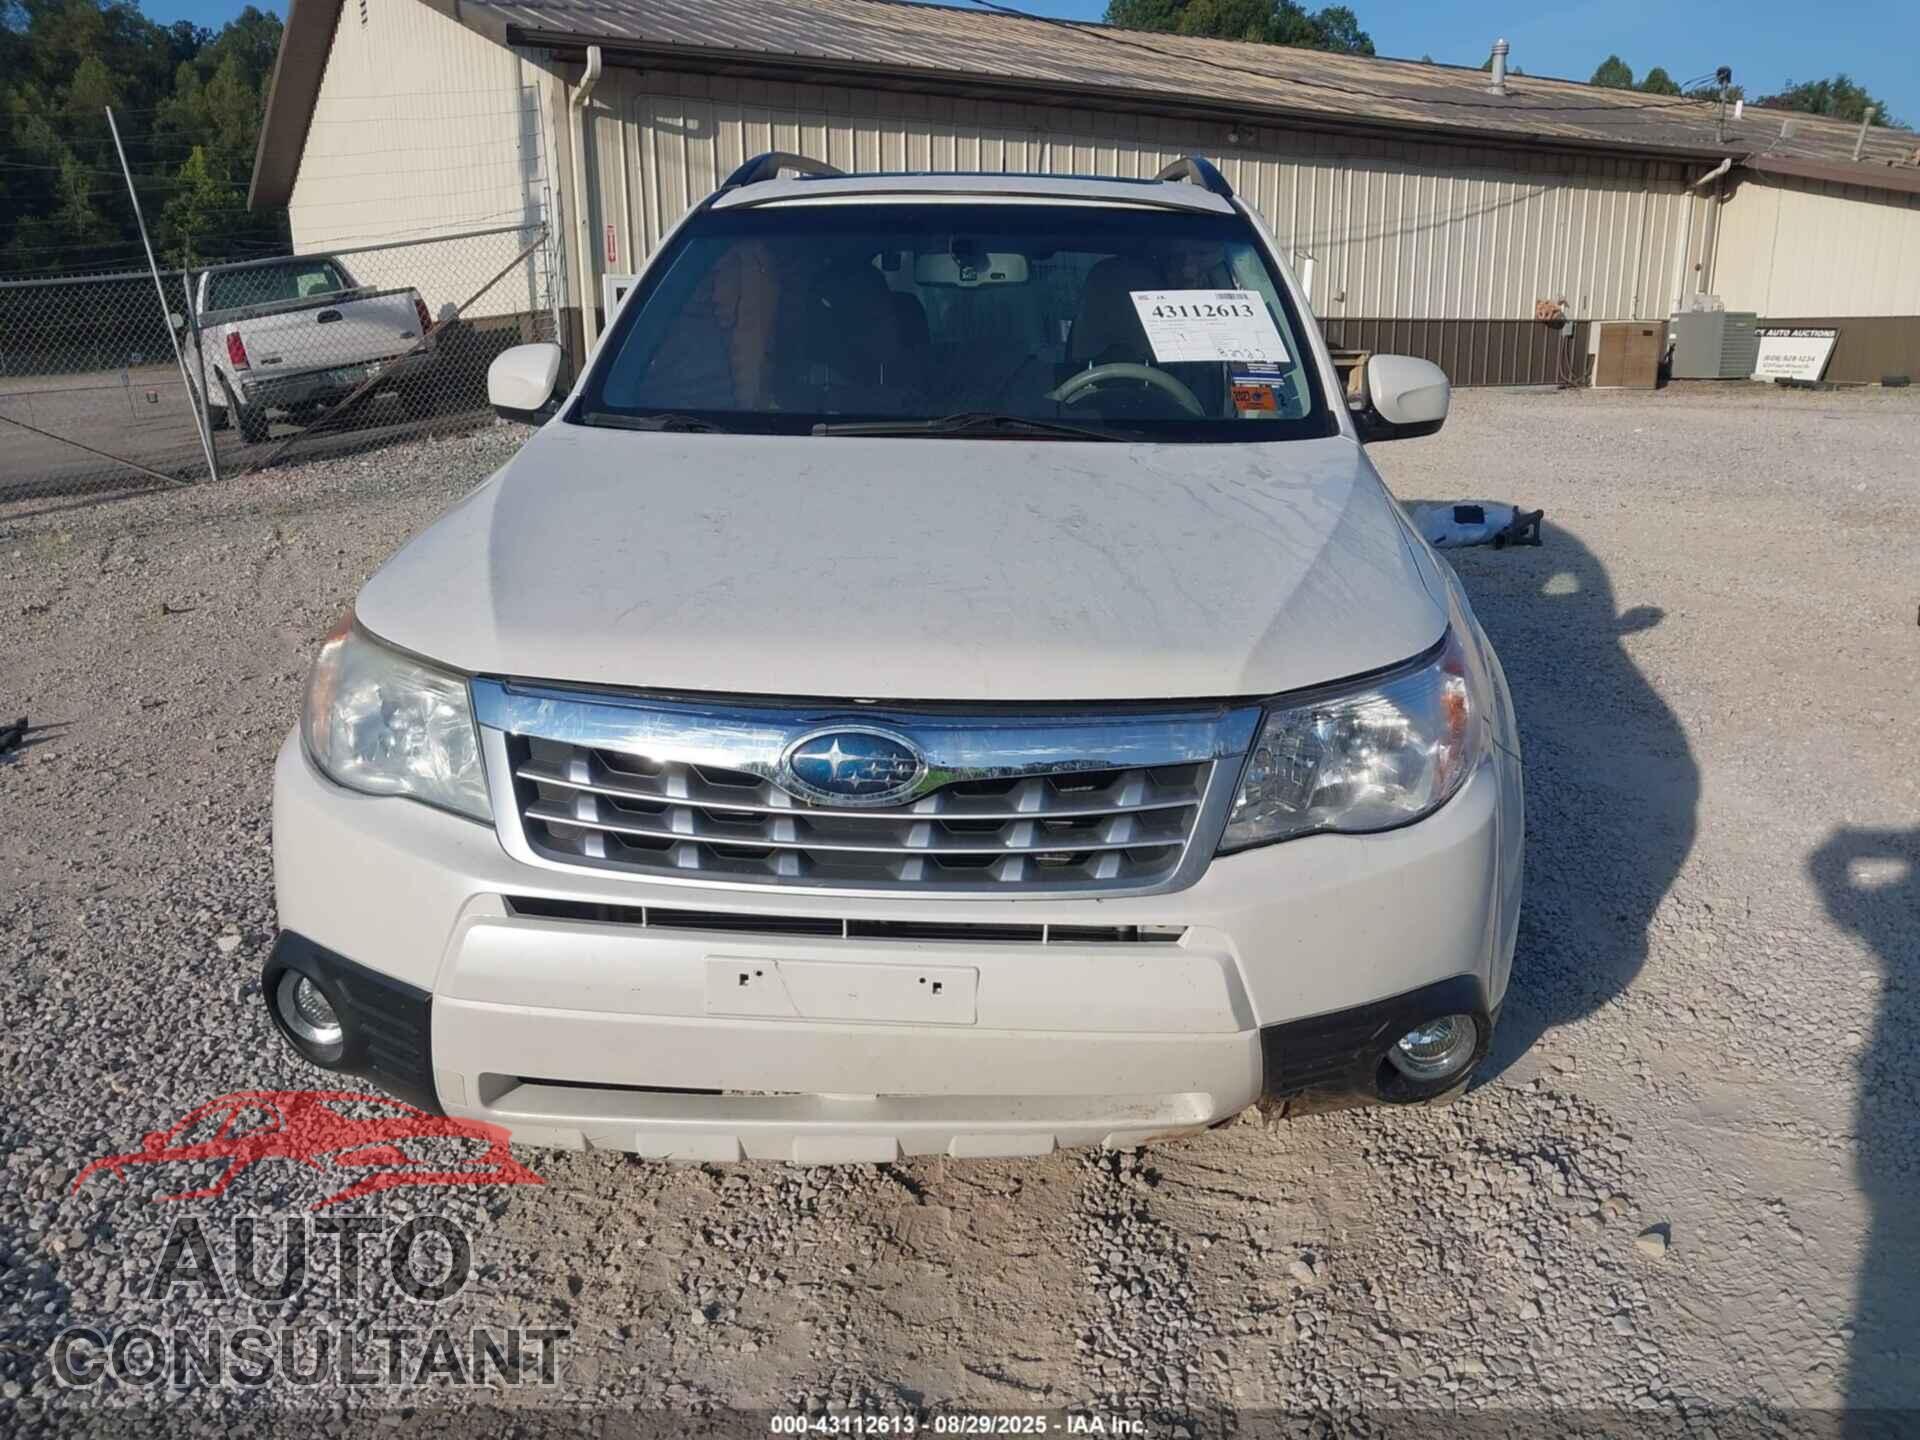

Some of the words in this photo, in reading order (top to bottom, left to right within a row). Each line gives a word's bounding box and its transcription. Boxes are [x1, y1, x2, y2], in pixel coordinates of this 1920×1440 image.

[1152, 304, 1254, 319] 43112613
[1767, 329, 1790, 337] AUTO
[1791, 329, 1835, 337] AUCTIONS
